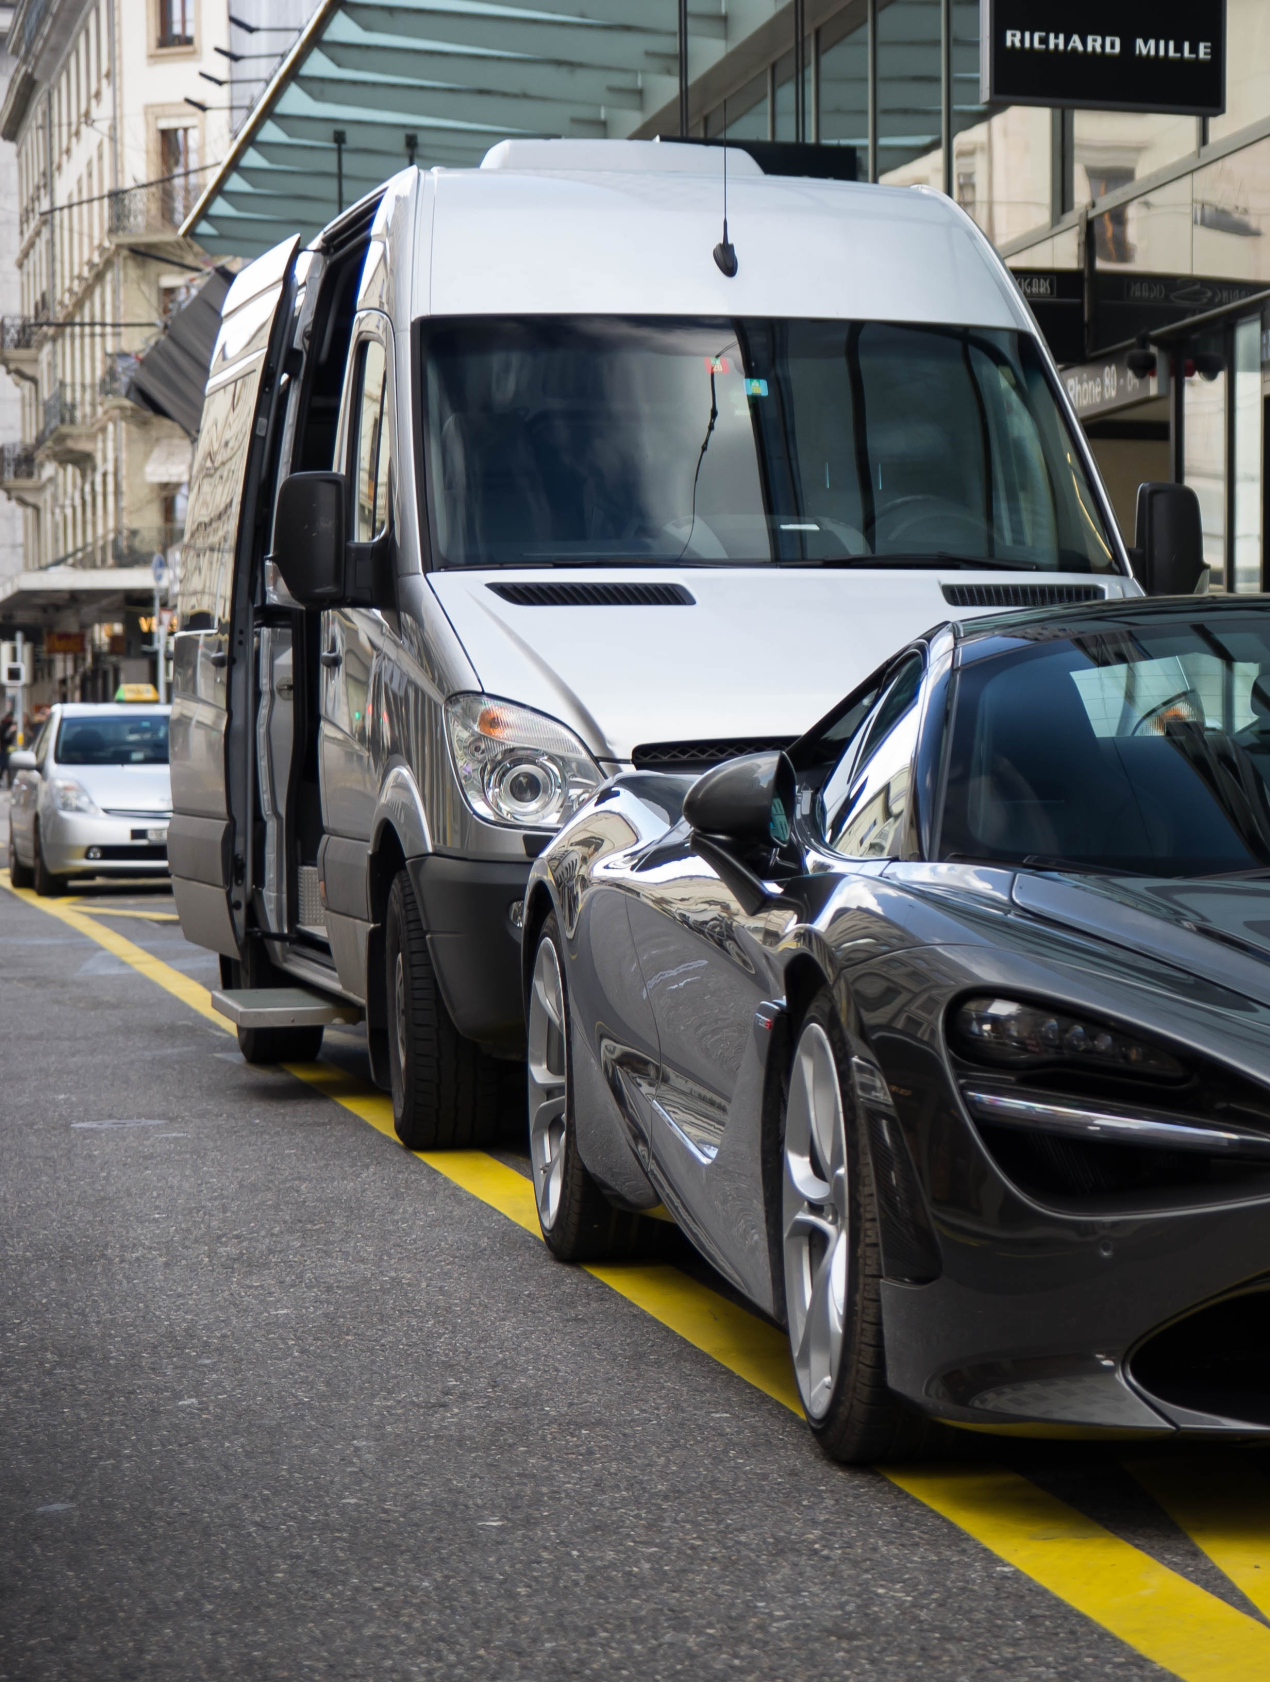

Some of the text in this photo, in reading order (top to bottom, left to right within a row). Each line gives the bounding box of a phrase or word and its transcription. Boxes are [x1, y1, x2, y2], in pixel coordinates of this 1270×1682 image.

[1005, 29, 1211, 59] RICHARD MILLE
[1104, 364, 1117, 399] 80
